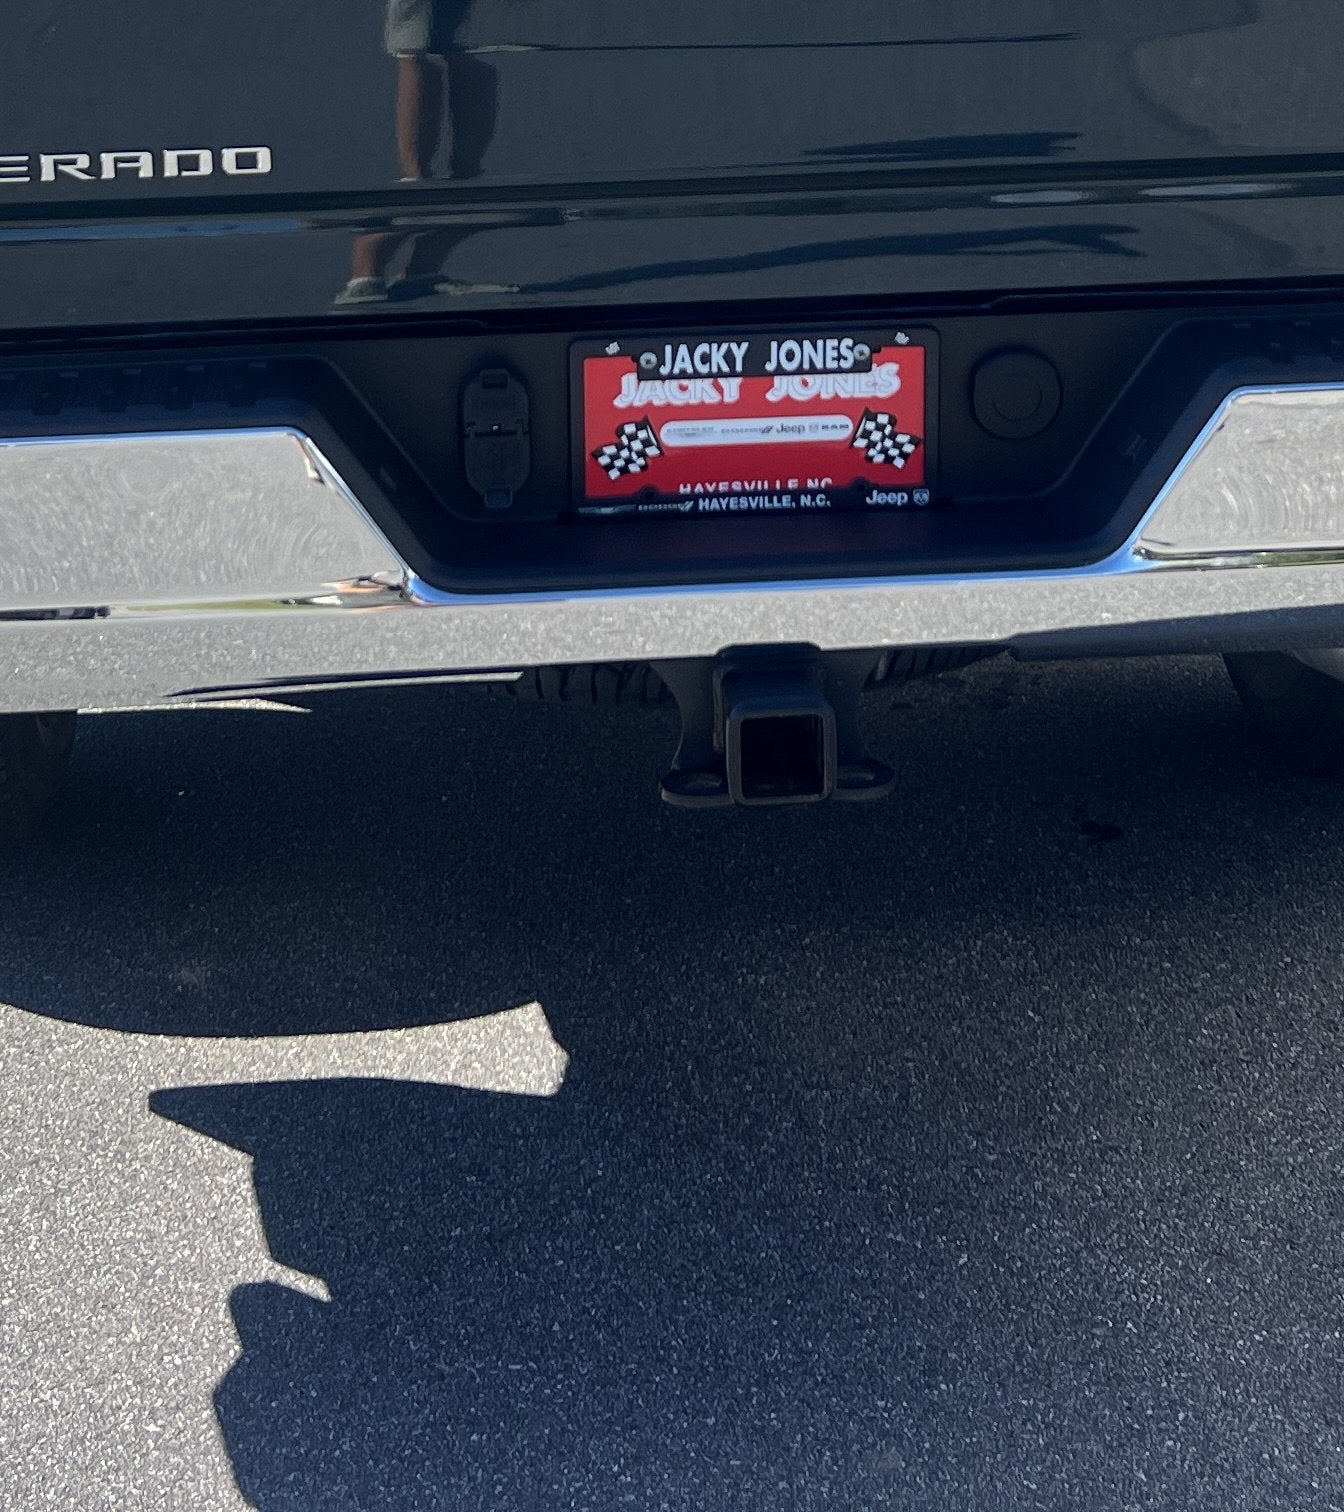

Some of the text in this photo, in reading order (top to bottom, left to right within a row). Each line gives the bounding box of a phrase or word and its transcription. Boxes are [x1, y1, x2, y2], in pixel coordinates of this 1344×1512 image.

[659, 338, 855, 376] JACKY JONES
[775, 422, 806, 435] Jeep
[698, 494, 796, 511] HAYESVILLE,
[800, 493, 831, 509] N.C.
[865, 488, 909, 507] Jeep
